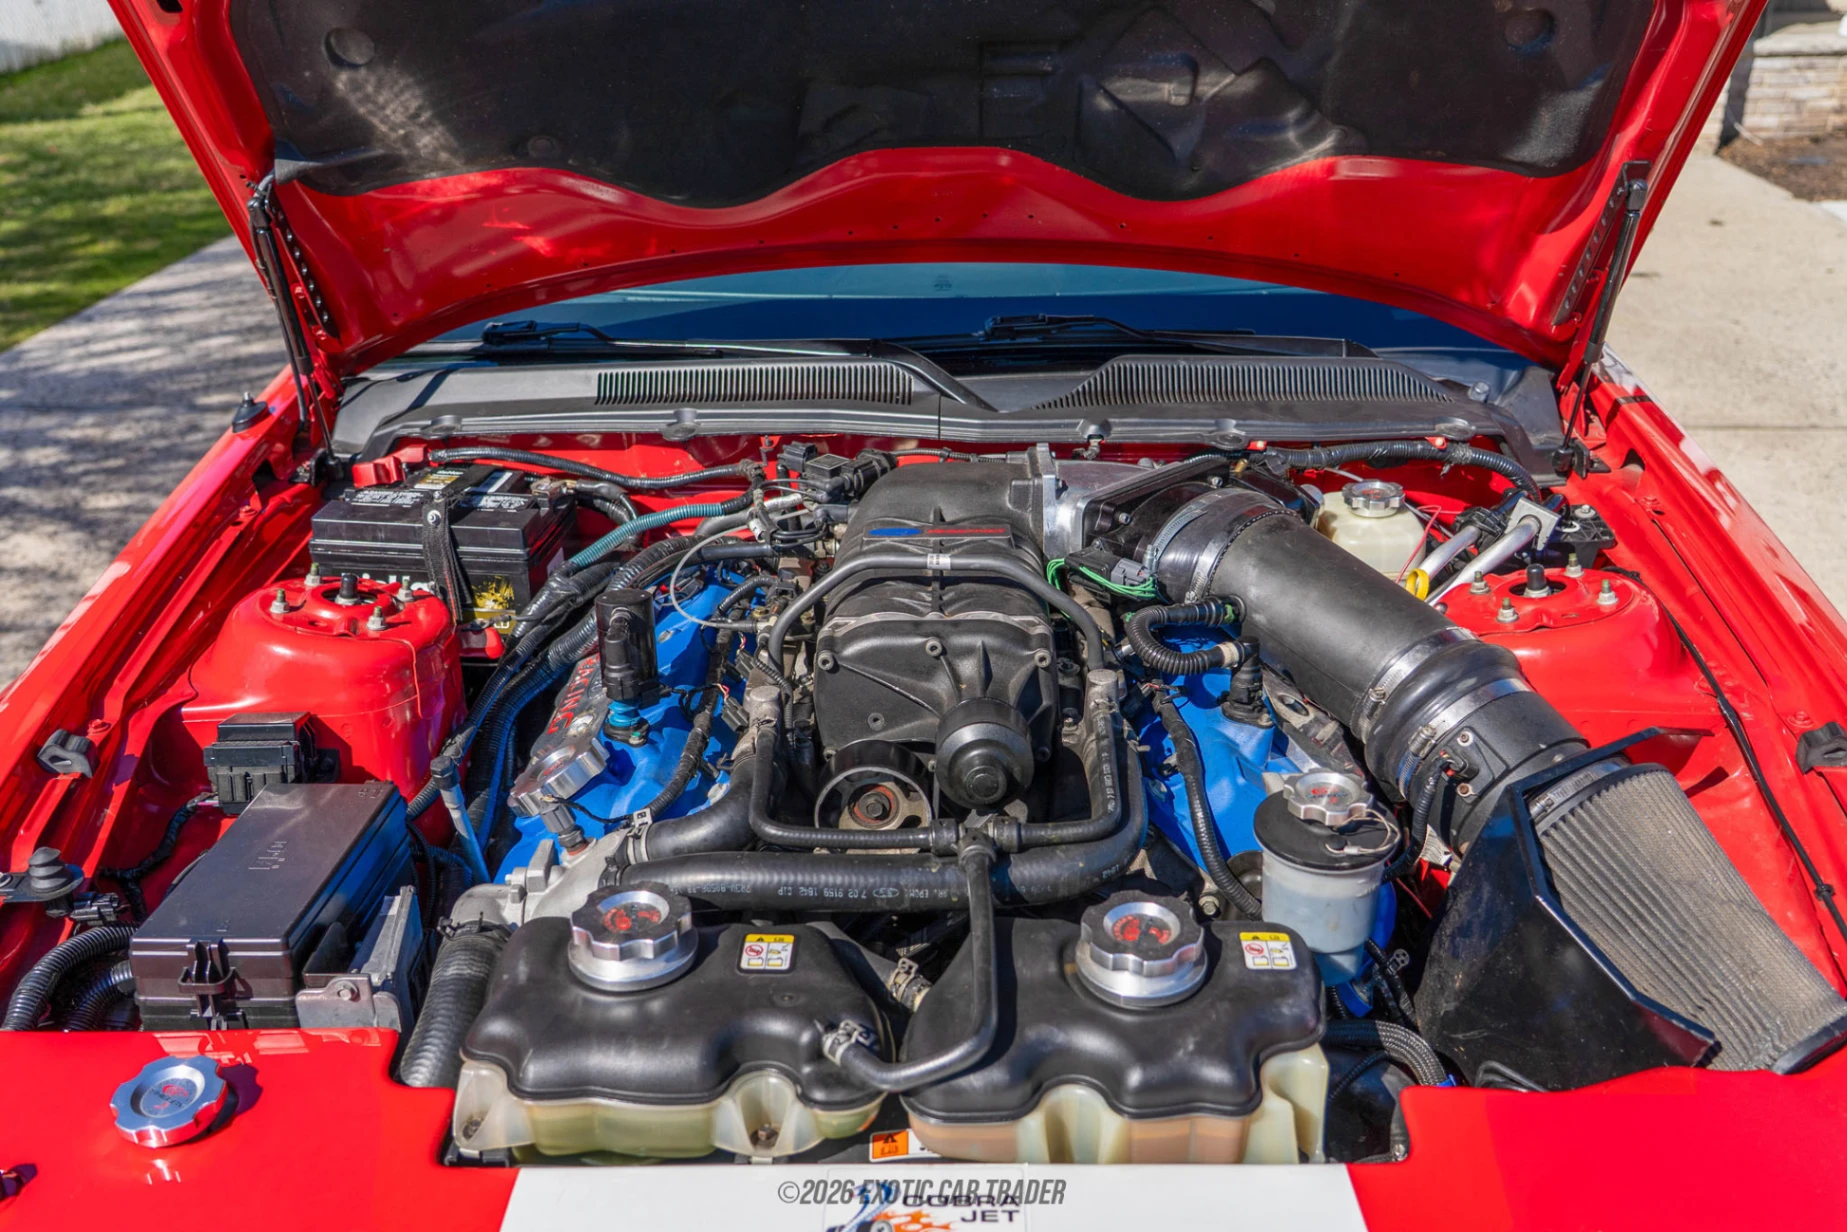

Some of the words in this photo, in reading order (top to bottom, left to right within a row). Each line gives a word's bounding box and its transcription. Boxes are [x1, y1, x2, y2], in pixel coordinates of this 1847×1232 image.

[823, 887, 844, 898] 9159
[902, 1194, 1020, 1208] COBRA
[960, 1210, 1020, 1223] JET
